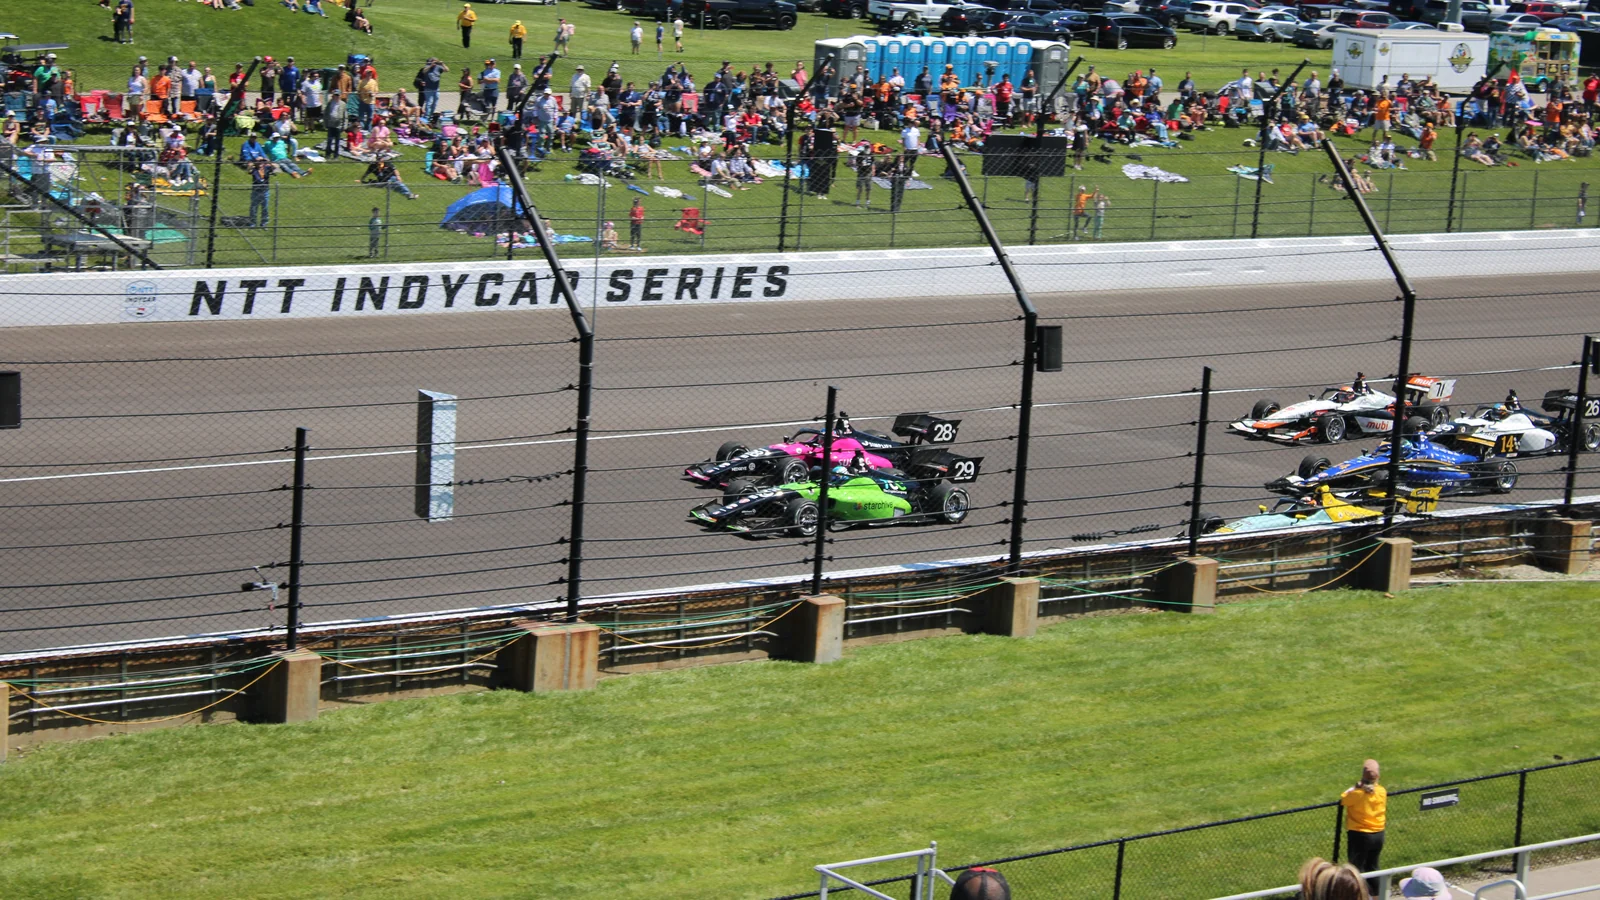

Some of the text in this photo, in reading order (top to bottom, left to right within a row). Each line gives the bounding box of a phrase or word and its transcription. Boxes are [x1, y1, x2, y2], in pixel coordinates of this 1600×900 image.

[189, 279, 305, 315] NTT
[606, 266, 790, 302] SERIES
[1435, 382, 1446, 397] 71
[1584, 400, 1600, 417] 26
[933, 423, 952, 441] 28
[1366, 419, 1389, 430] mubi
[1500, 435, 1514, 453] 14
[954, 461, 975, 481] 29
[863, 501, 894, 511] starchive
